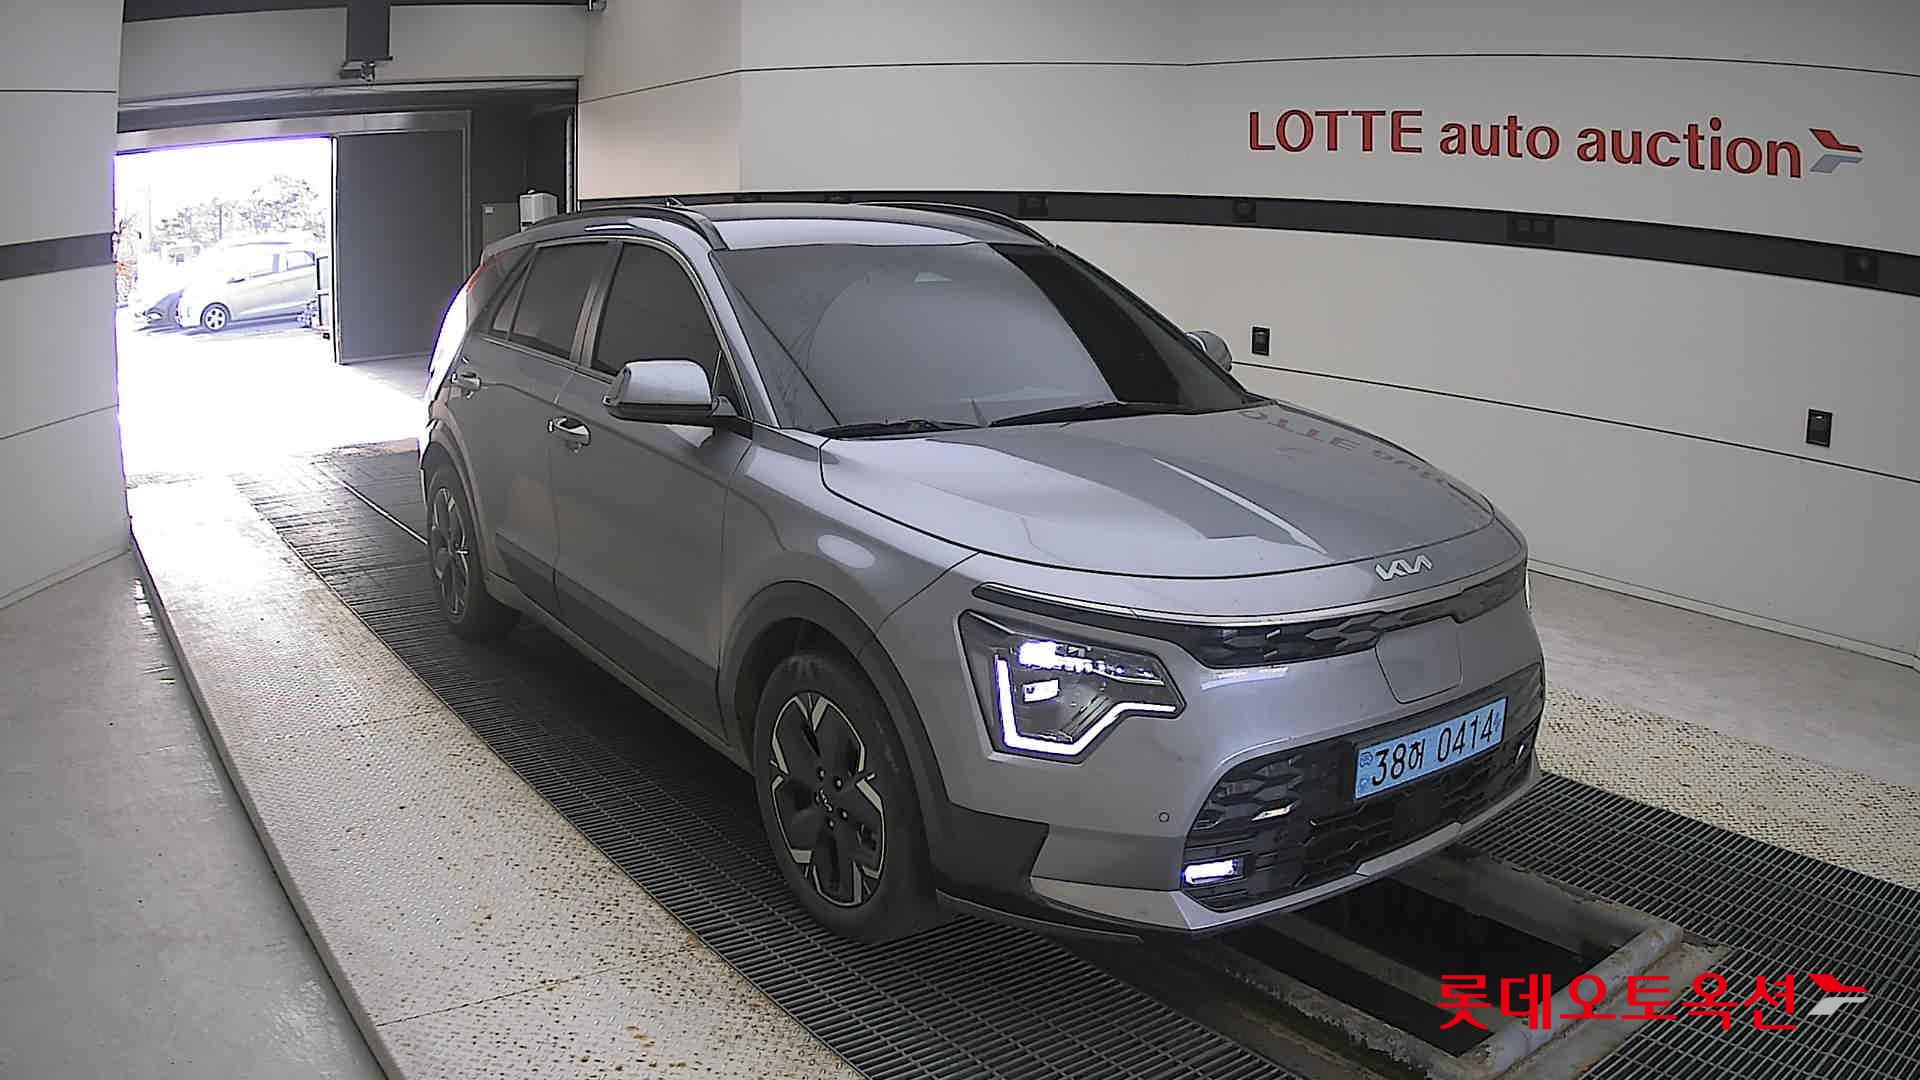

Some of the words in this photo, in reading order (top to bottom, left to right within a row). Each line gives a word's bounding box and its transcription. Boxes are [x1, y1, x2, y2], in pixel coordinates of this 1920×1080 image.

[1249, 110, 1423, 153] LOTTE
[1440, 115, 1560, 160] auto
[1577, 117, 1801, 178] auction
[1371, 738, 1426, 786] 38허
[1437, 708, 1494, 763] 0414
